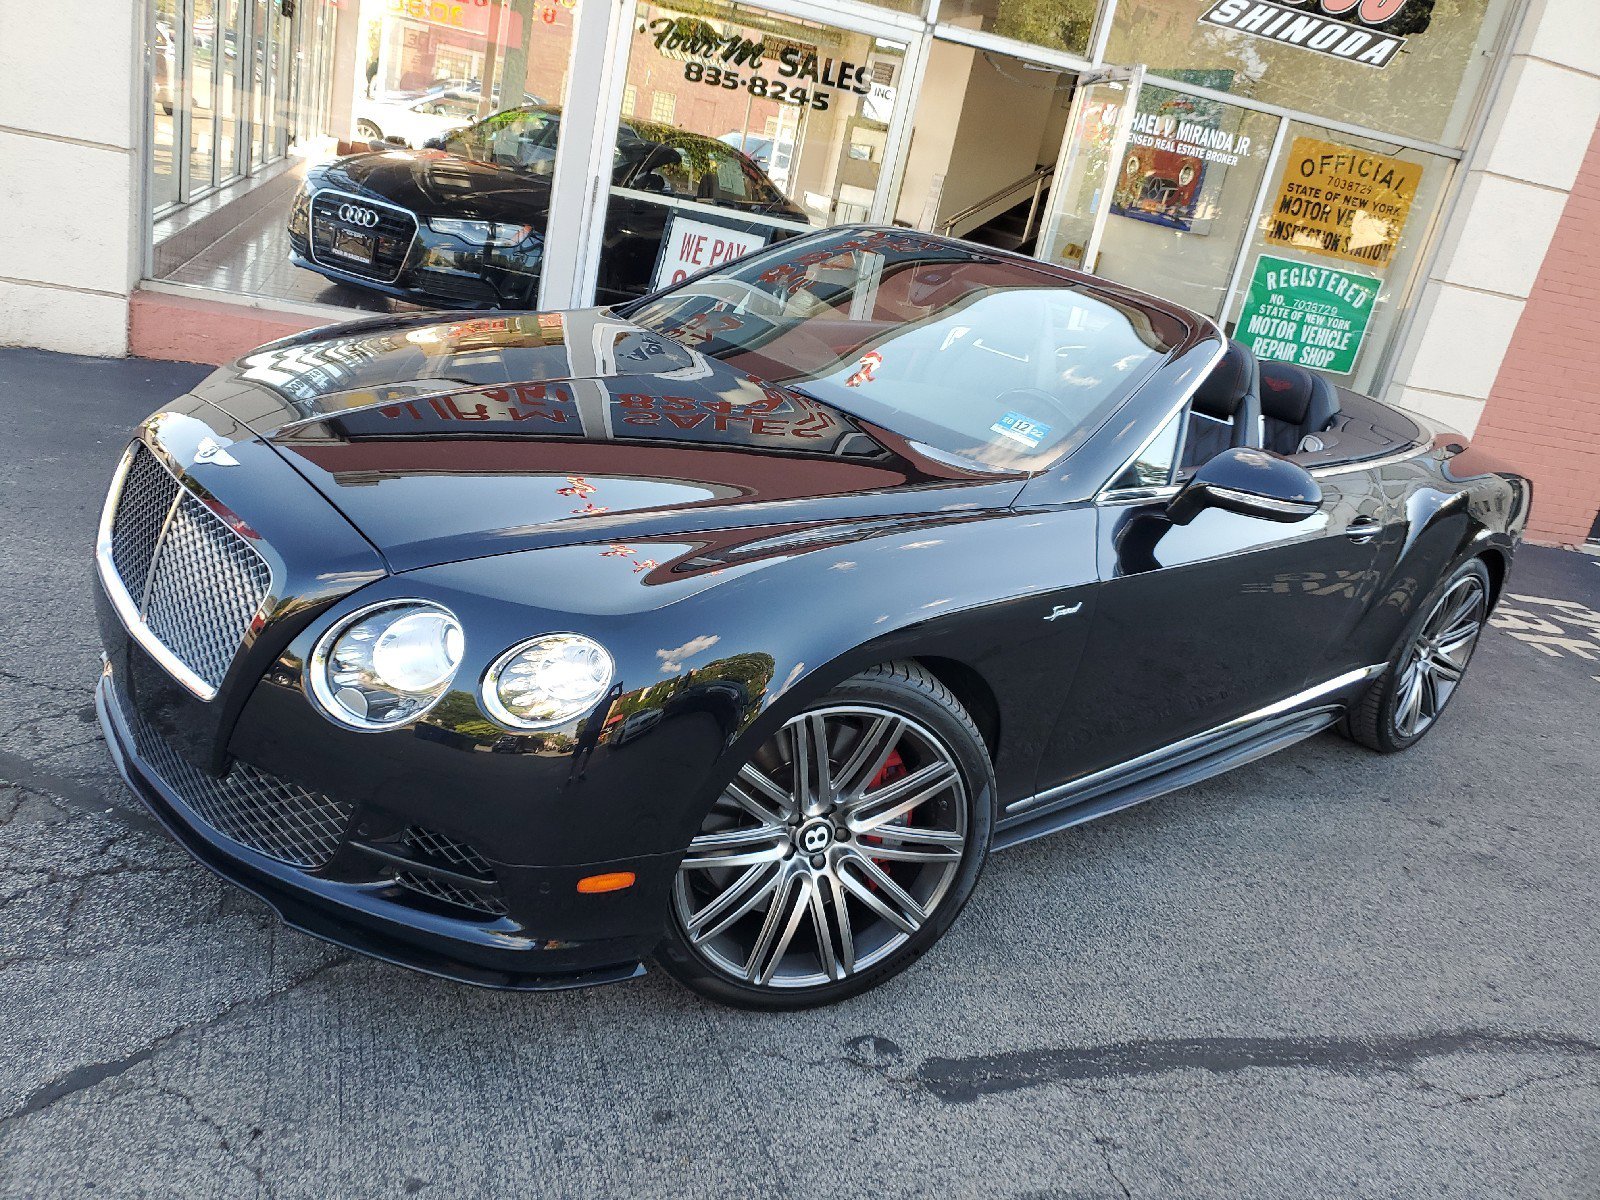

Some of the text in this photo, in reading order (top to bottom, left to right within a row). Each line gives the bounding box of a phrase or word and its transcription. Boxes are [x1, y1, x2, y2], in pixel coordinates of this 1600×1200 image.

[1209, 0, 1399, 65] SHINODA
[777, 46, 871, 95] SALES
[1154, 138, 1176, 152] REAL
[1176, 143, 1205, 159] ESTATE
[1205, 150, 1238, 167] BROKER
[1176, 121, 1233, 151] MIRANDA
[1234, 136, 1251, 157] JR.
[1300, 154, 1406, 199] OFFICIAL
[1279, 195, 1332, 223] MOTOR
[1286, 182, 1401, 216] STATE OF NEW YORK
[679, 232, 708, 265] WE
[1266, 267, 1367, 309] REGISTERED
[1258, 303, 1351, 330] STATE OF NEW YORK
[1269, 293, 1338, 317] NO. 7038729
[1247, 314, 1352, 351] MOTOR VEHICLE
[1251, 336, 1336, 368] REPAIR SHOP
[1014, 420, 1031, 432] 12
